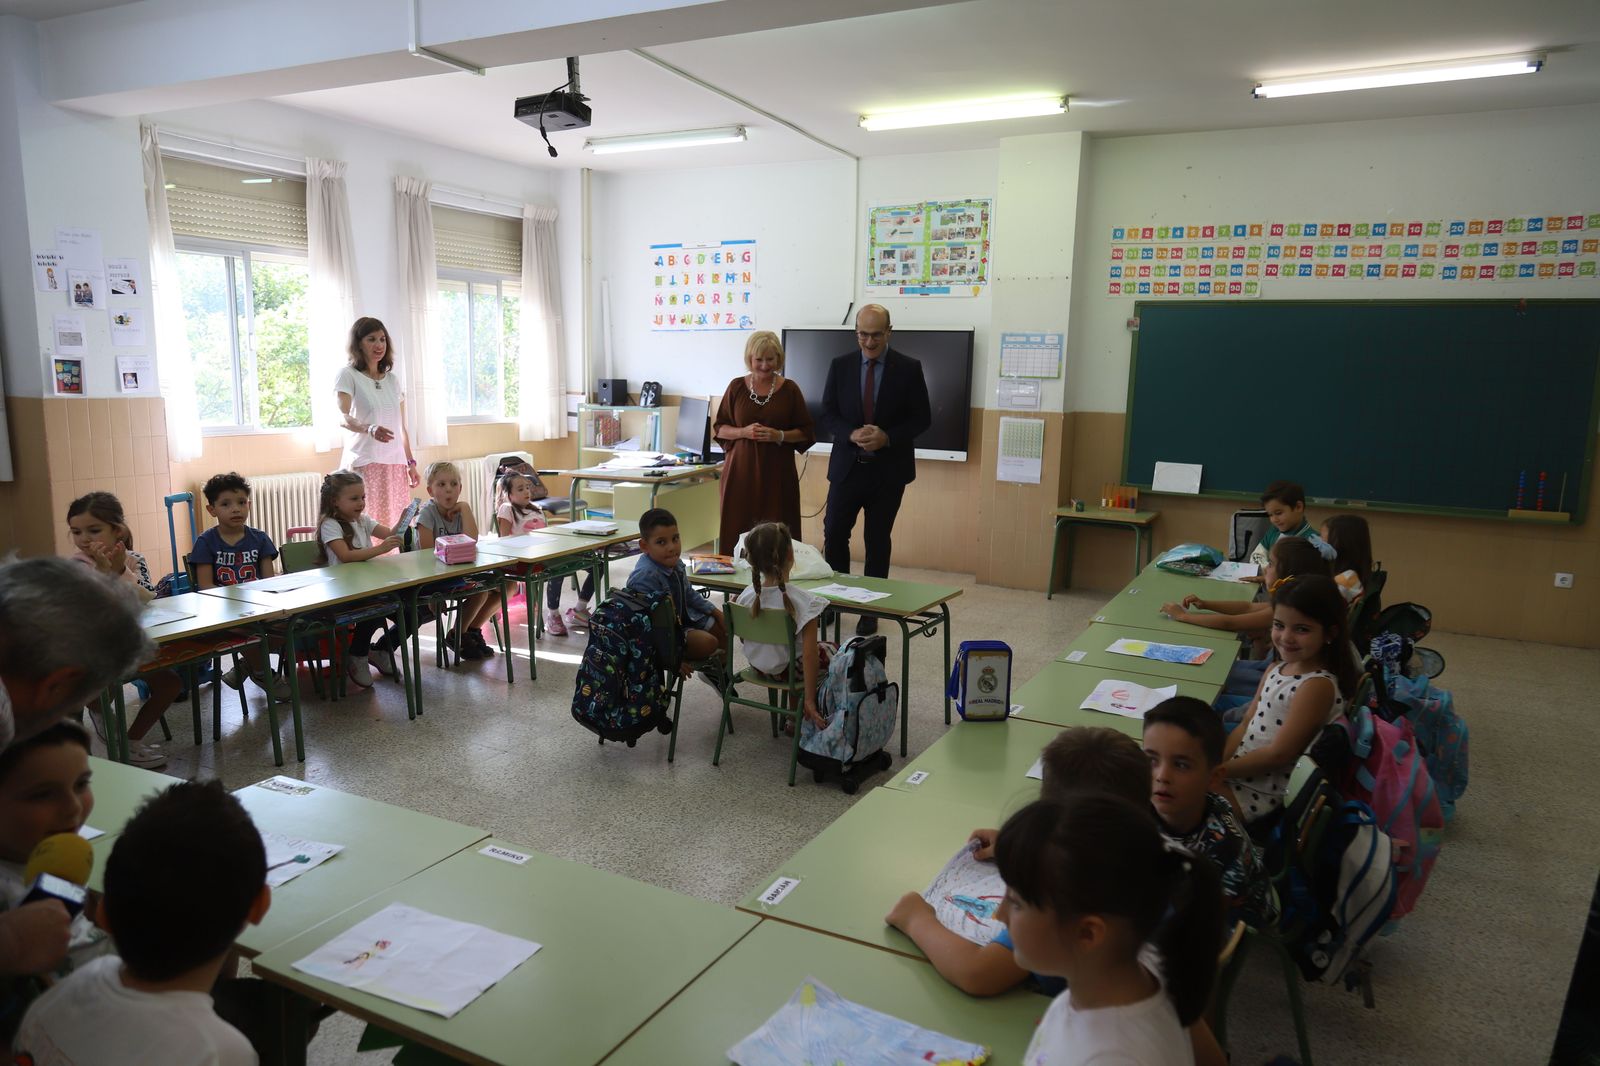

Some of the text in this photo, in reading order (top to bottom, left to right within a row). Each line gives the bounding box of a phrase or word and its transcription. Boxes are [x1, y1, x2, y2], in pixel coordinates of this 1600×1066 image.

[668, 256, 674, 266] B
[698, 254, 705, 264] D
[714, 253, 720, 263] E
[742, 252, 750, 262] G
[697, 274, 704, 284] K
[726, 273, 735, 283] M
[743, 272, 750, 282] N
[684, 295, 690, 304] P
[696, 294, 705, 304] Q
[713, 294, 720, 304] R
[727, 292, 732, 303] S
[726, 313, 734, 324] Z
